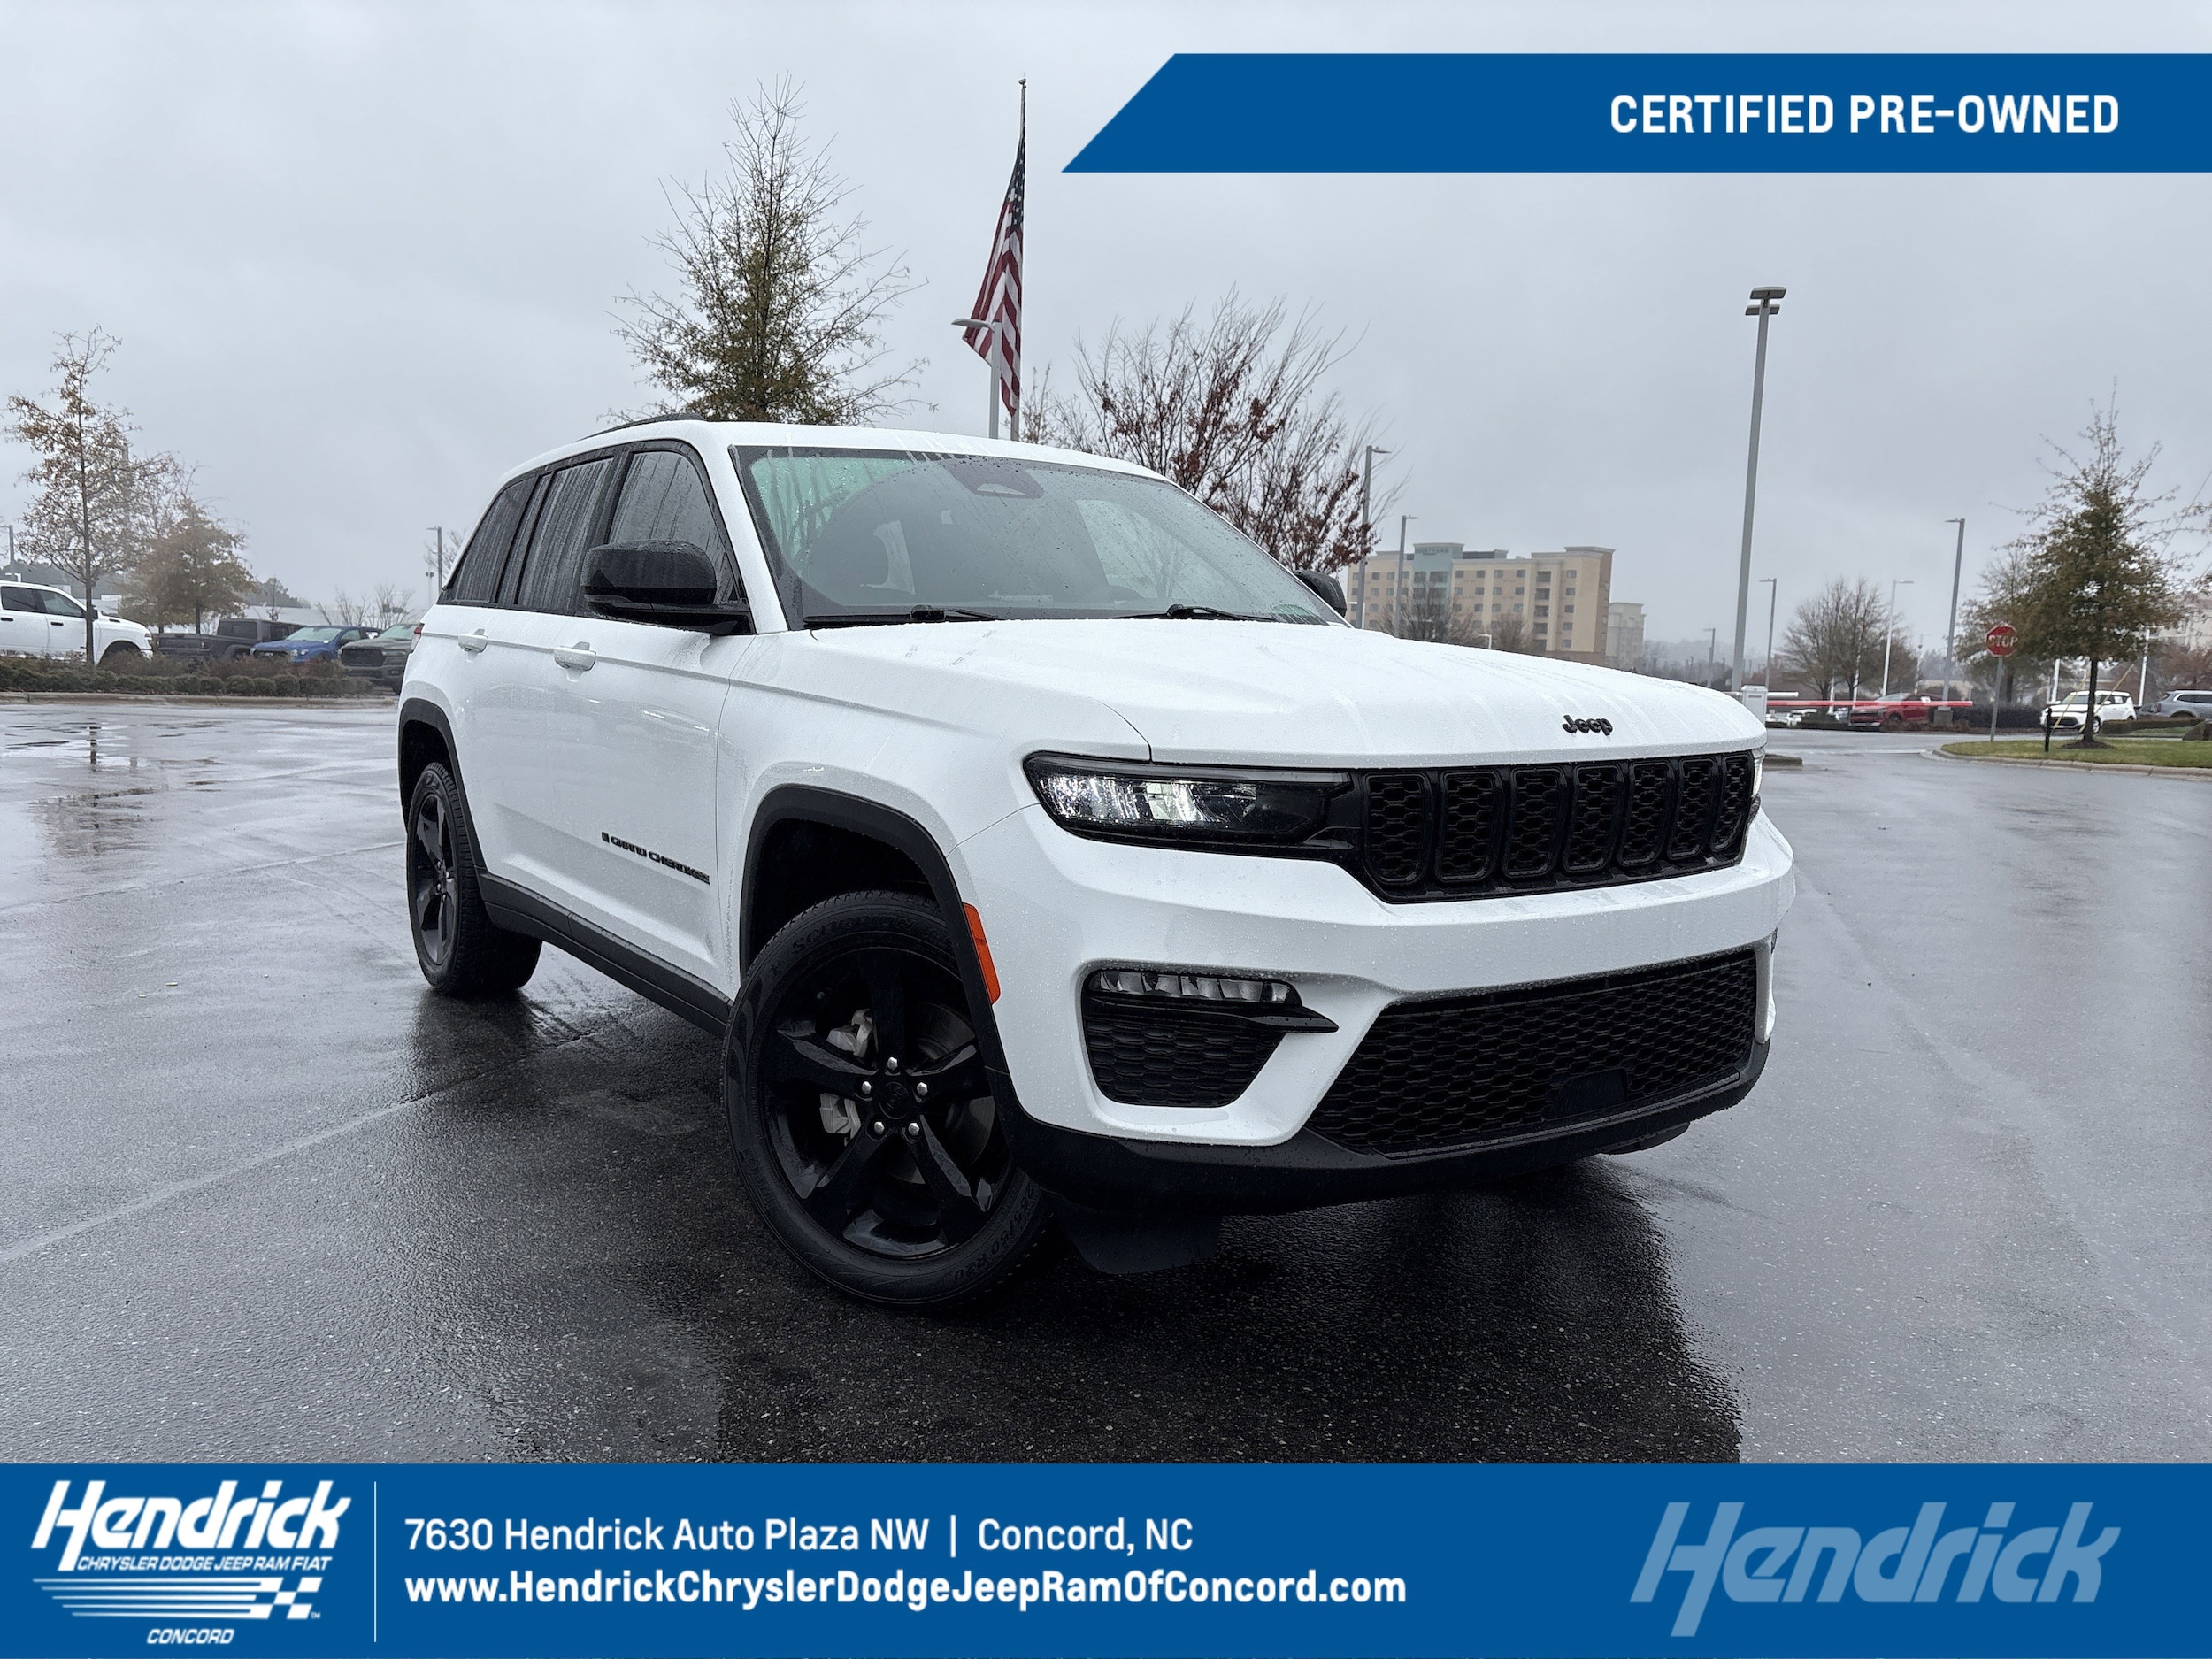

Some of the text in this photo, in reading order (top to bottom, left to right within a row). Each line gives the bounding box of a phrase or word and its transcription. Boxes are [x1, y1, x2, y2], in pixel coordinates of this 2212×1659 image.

[1988, 634, 2018, 648] STOP
[1562, 714, 1613, 736] Jeep
[649, 851, 710, 886] CHEROKEE
